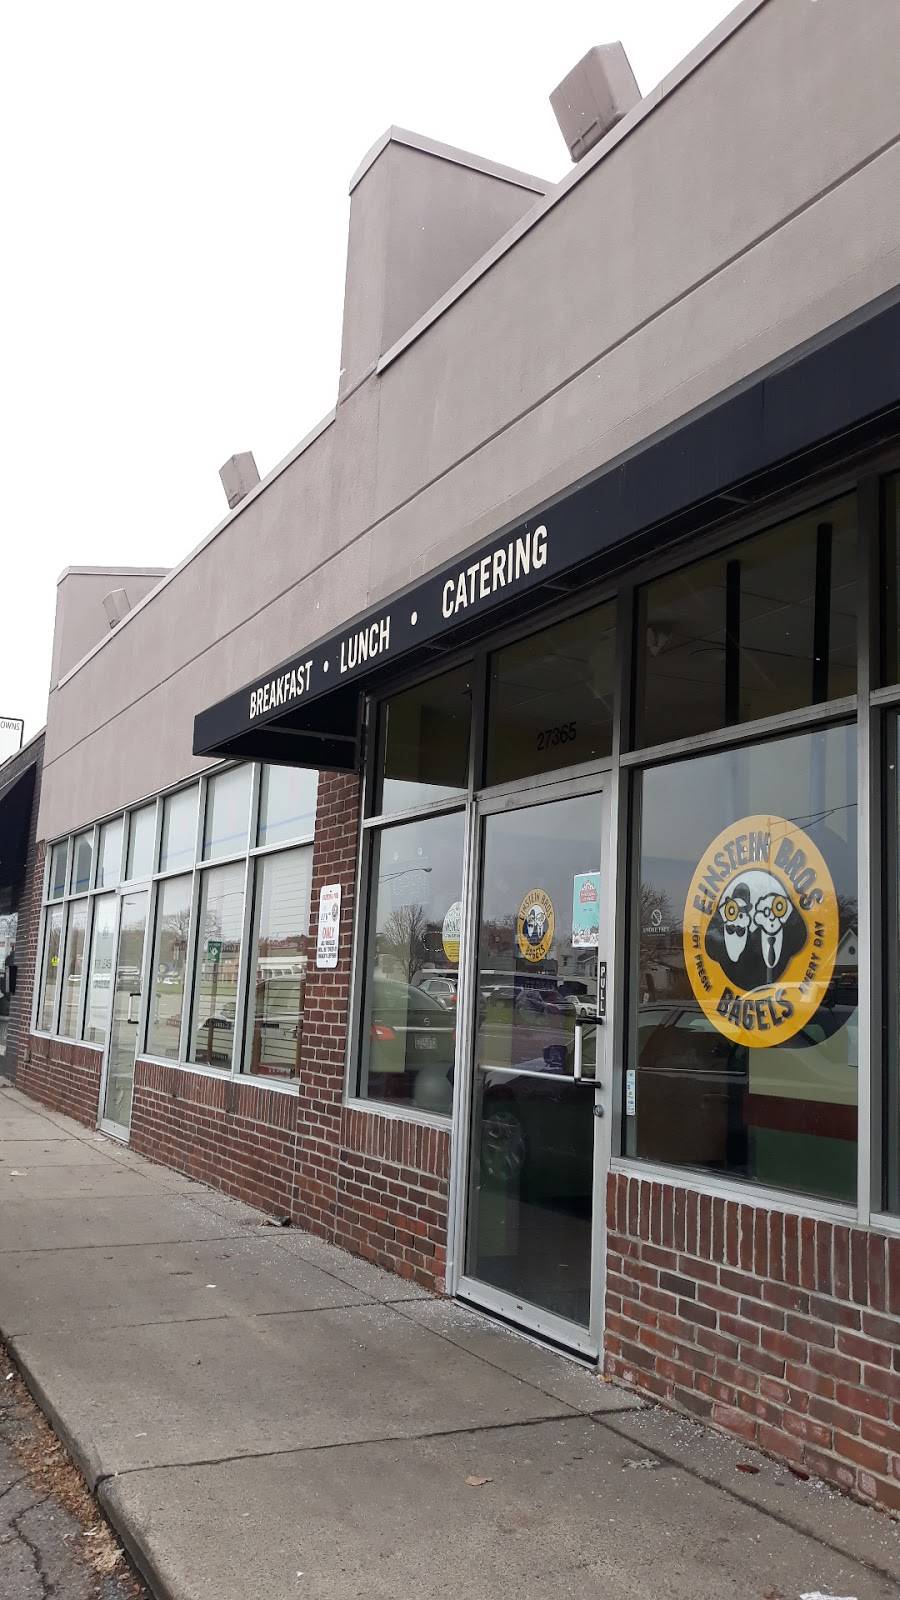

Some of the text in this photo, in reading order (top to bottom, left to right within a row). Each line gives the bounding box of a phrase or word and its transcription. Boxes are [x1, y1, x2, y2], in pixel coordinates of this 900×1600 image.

[249, 525, 548, 719] BREAKFAST LUNCH CATERING
[536, 721, 577, 751] 27365
[693, 831, 824, 916] EINSTEIN BROS
[691, 925, 713, 994] HOT FRESH
[798, 920, 826, 995] EVERY DAY
[716, 986, 794, 1032] BAGELS
